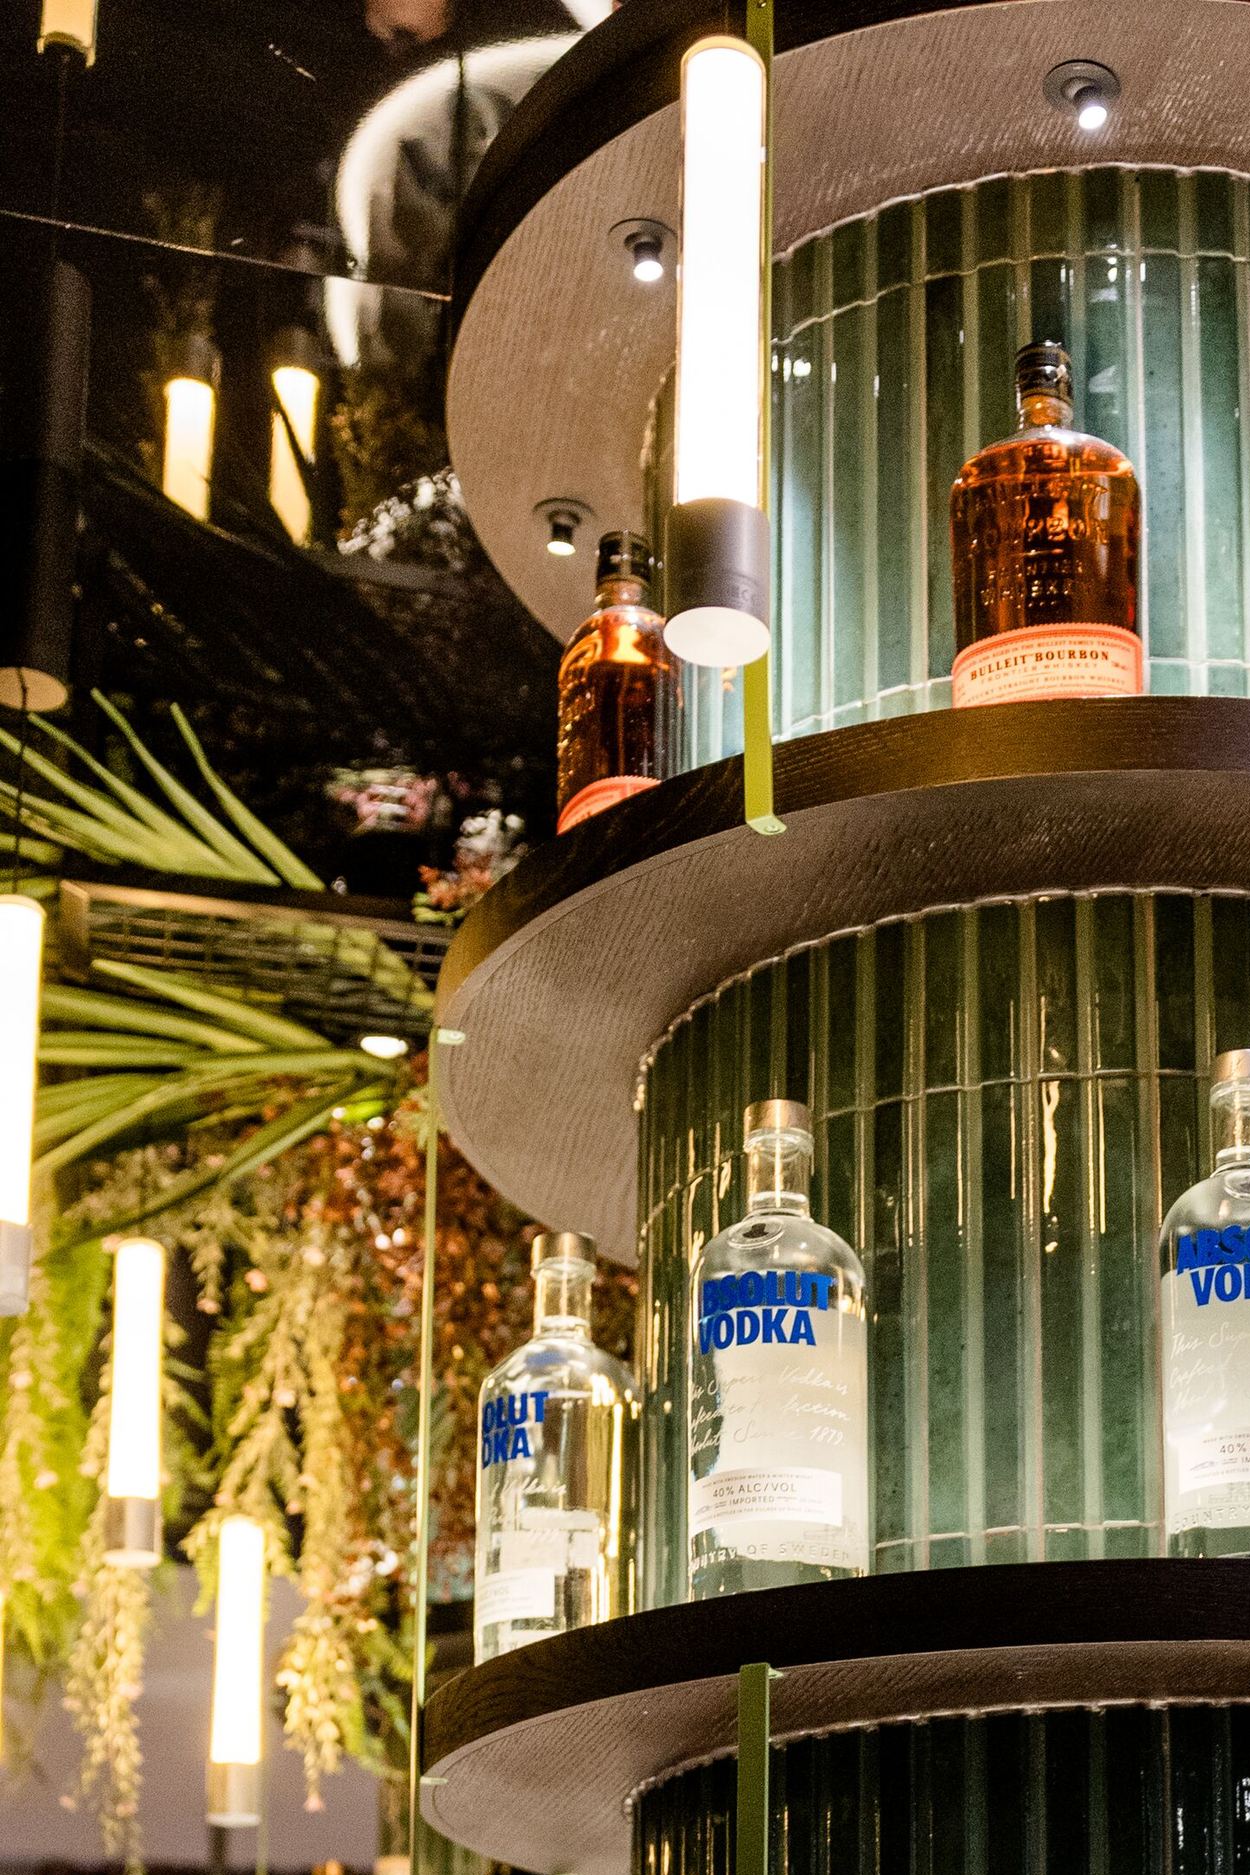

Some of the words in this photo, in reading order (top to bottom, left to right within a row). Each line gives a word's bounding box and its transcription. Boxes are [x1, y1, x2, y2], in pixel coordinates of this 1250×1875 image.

[970, 655, 1027, 680] BULLEIT
[1035, 649, 1109, 661] BOURBON
[699, 1308, 816, 1355] VODKA
[1219, 1442, 1247, 1454] 40%
[713, 1485, 734, 1498] 40%
[738, 1482, 798, 1494] ALC/VOL
[729, 1496, 775, 1506] IMPORTED
